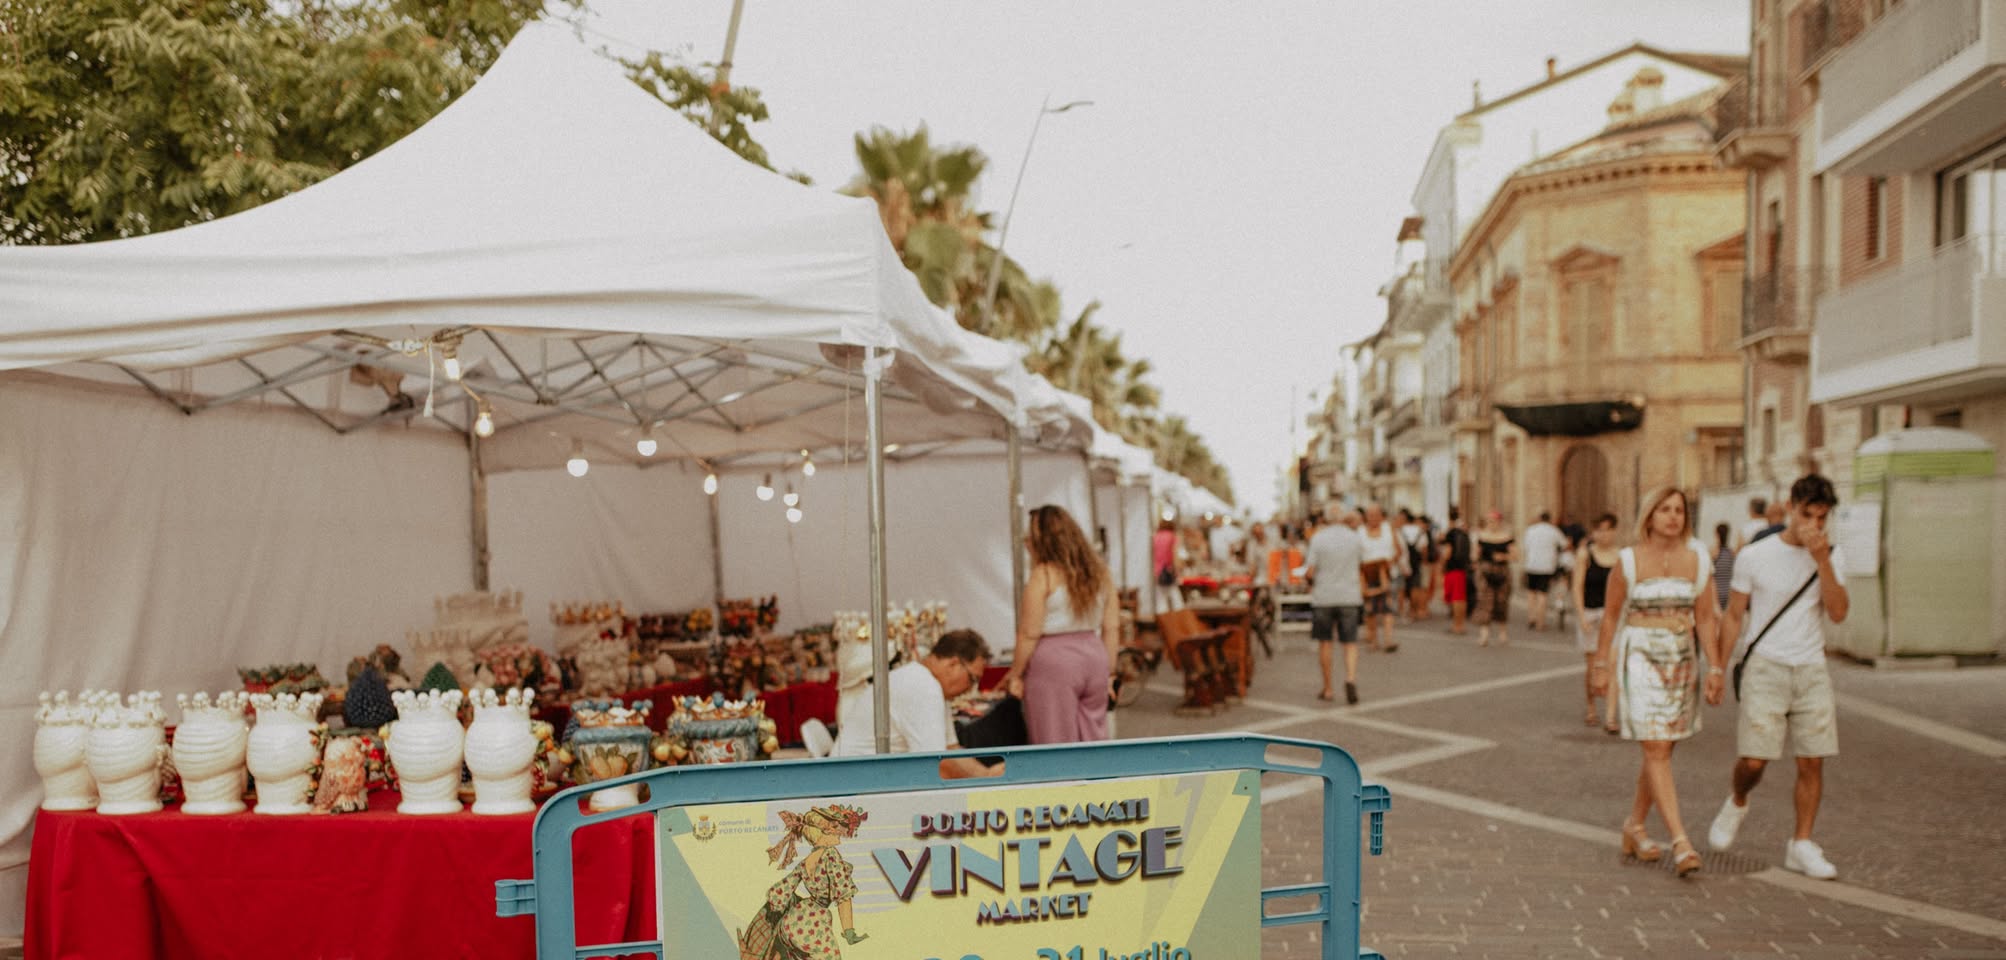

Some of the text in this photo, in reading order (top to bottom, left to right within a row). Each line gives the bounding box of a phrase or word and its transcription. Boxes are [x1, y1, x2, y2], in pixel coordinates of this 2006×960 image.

[744, 825, 778, 833] RECANATI
[912, 798, 1150, 838] PORTO RECANATI
[871, 826, 1185, 903] VINTAGE
[976, 892, 1093, 925] MARKET
